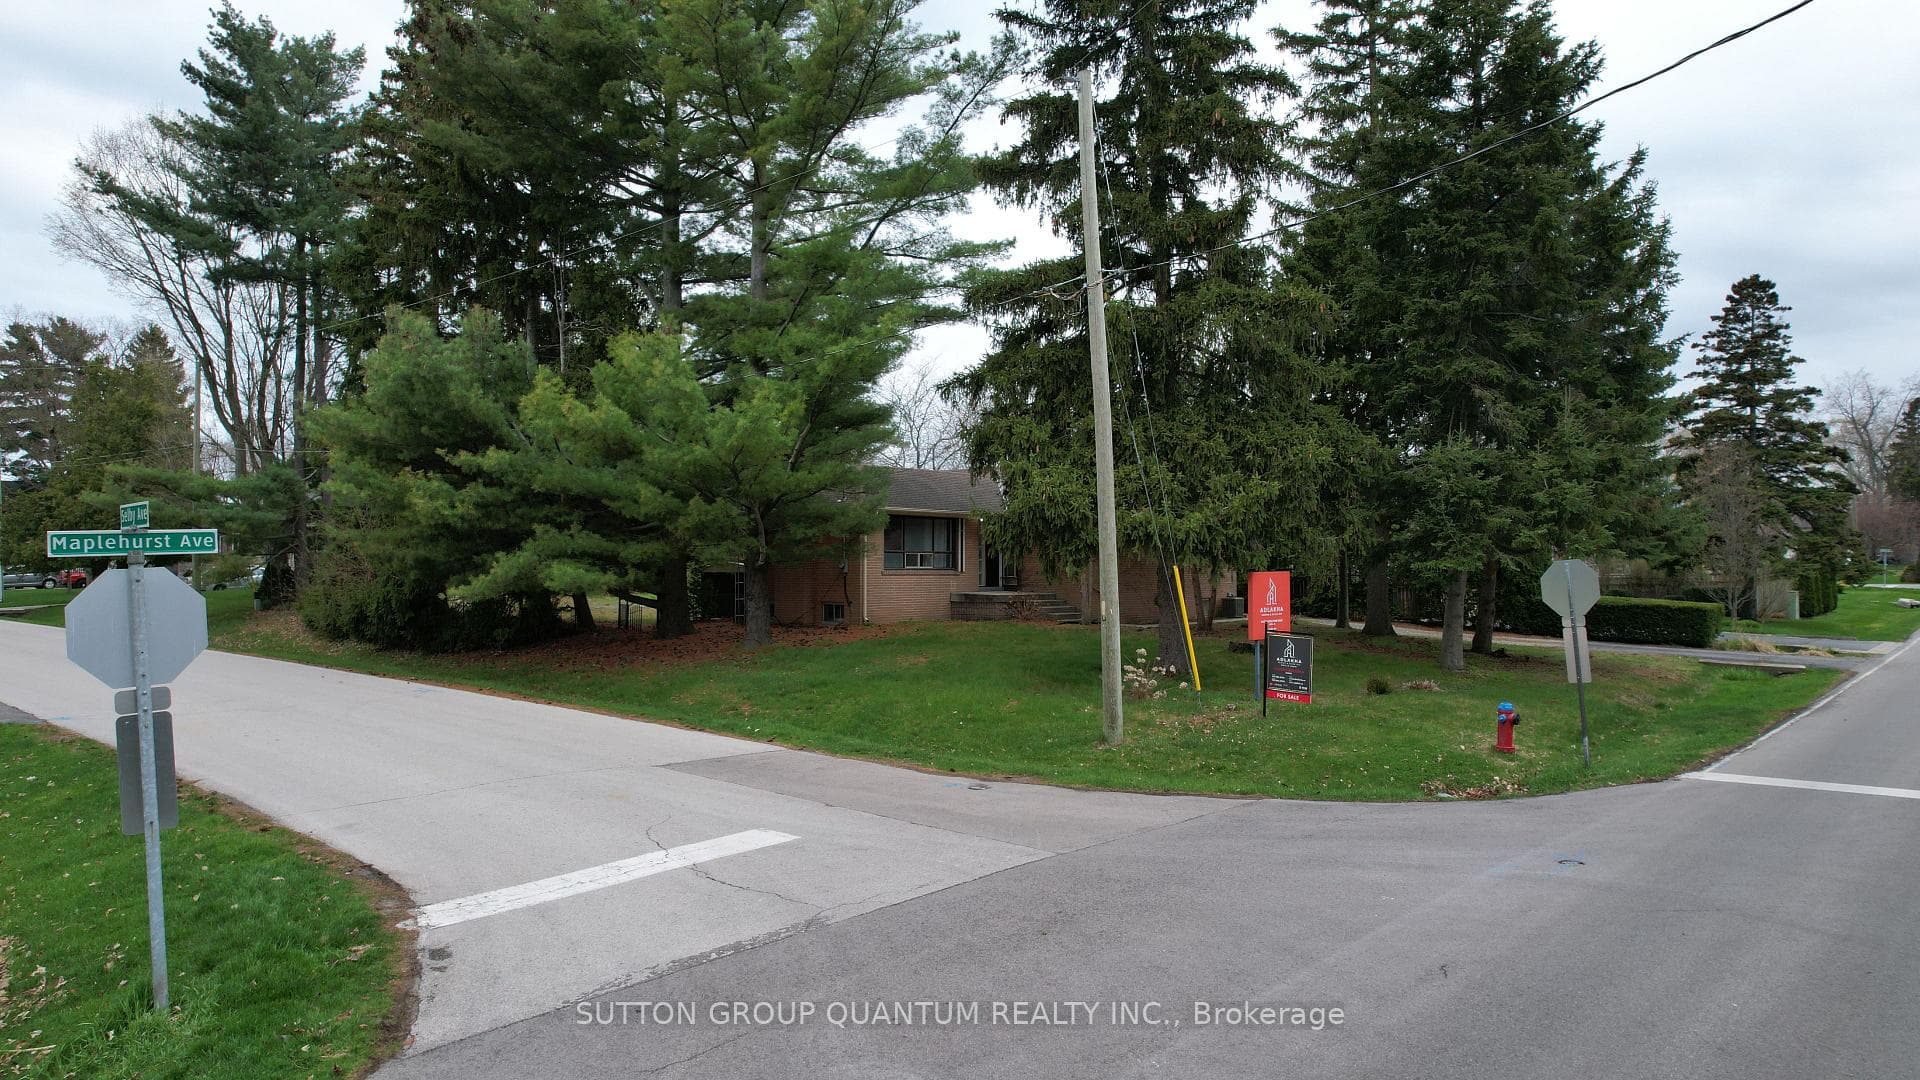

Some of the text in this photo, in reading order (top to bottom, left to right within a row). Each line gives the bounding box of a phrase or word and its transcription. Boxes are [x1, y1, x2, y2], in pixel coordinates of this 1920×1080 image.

[121, 507, 147, 525] Selby Ave
[52, 535, 213, 552] Maplehurst Ave
